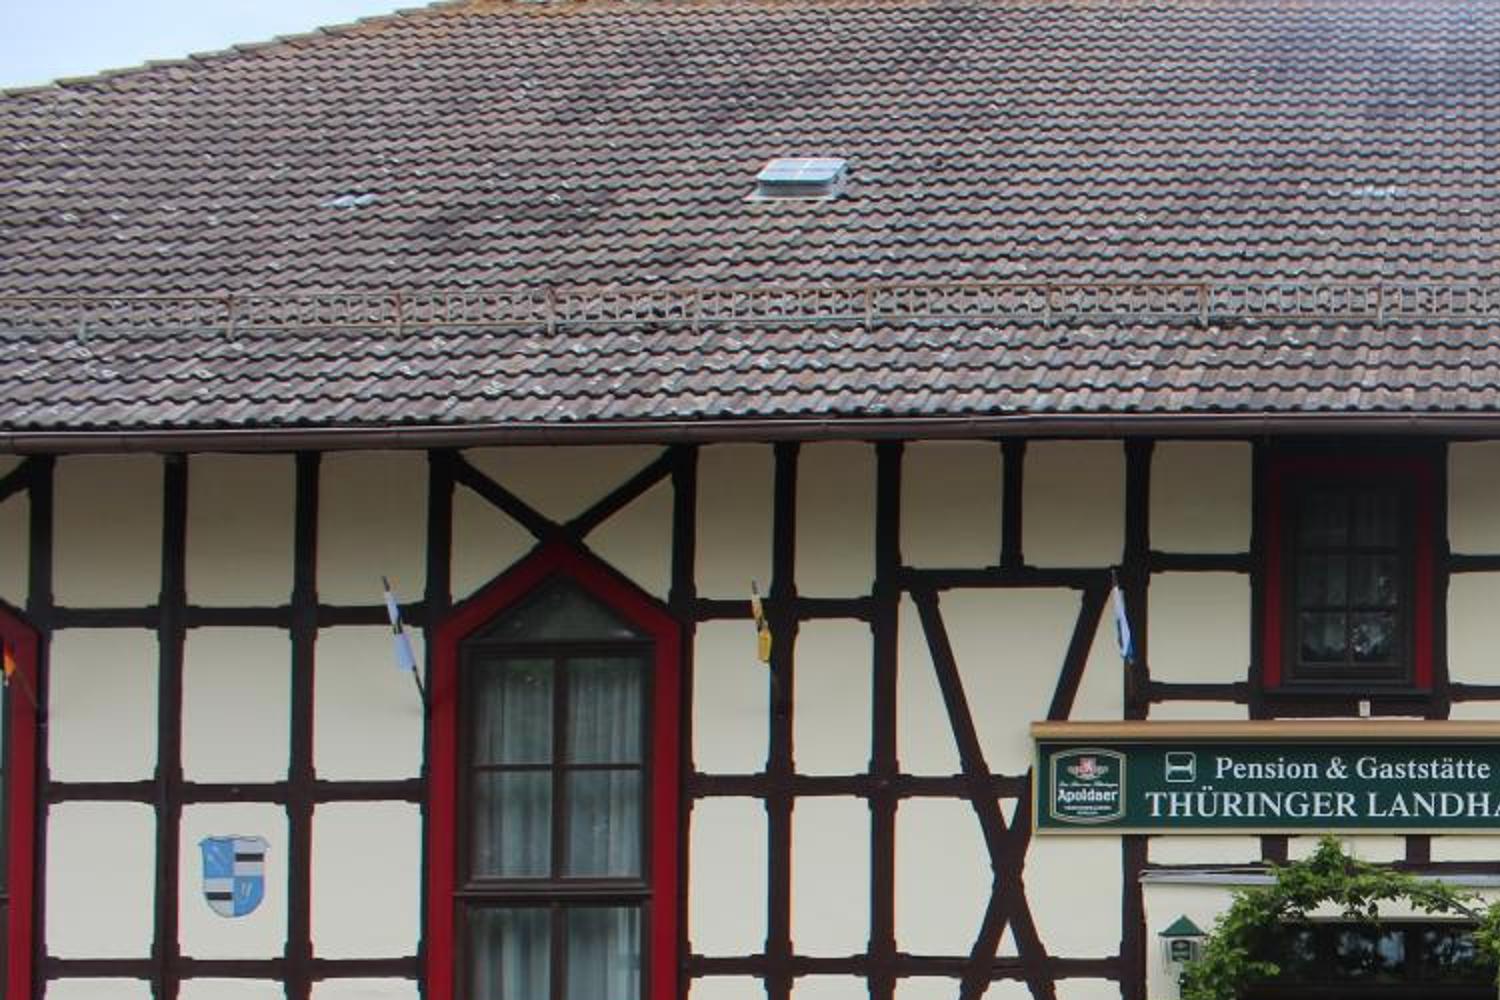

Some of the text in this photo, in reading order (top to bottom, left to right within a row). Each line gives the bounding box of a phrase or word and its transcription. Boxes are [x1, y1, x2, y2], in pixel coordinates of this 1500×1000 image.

[1215, 756, 1491, 780] Pension & Gaststätte
[1057, 788, 1118, 803] Apoldaer
[1145, 785, 1359, 817] THÜRINGER
